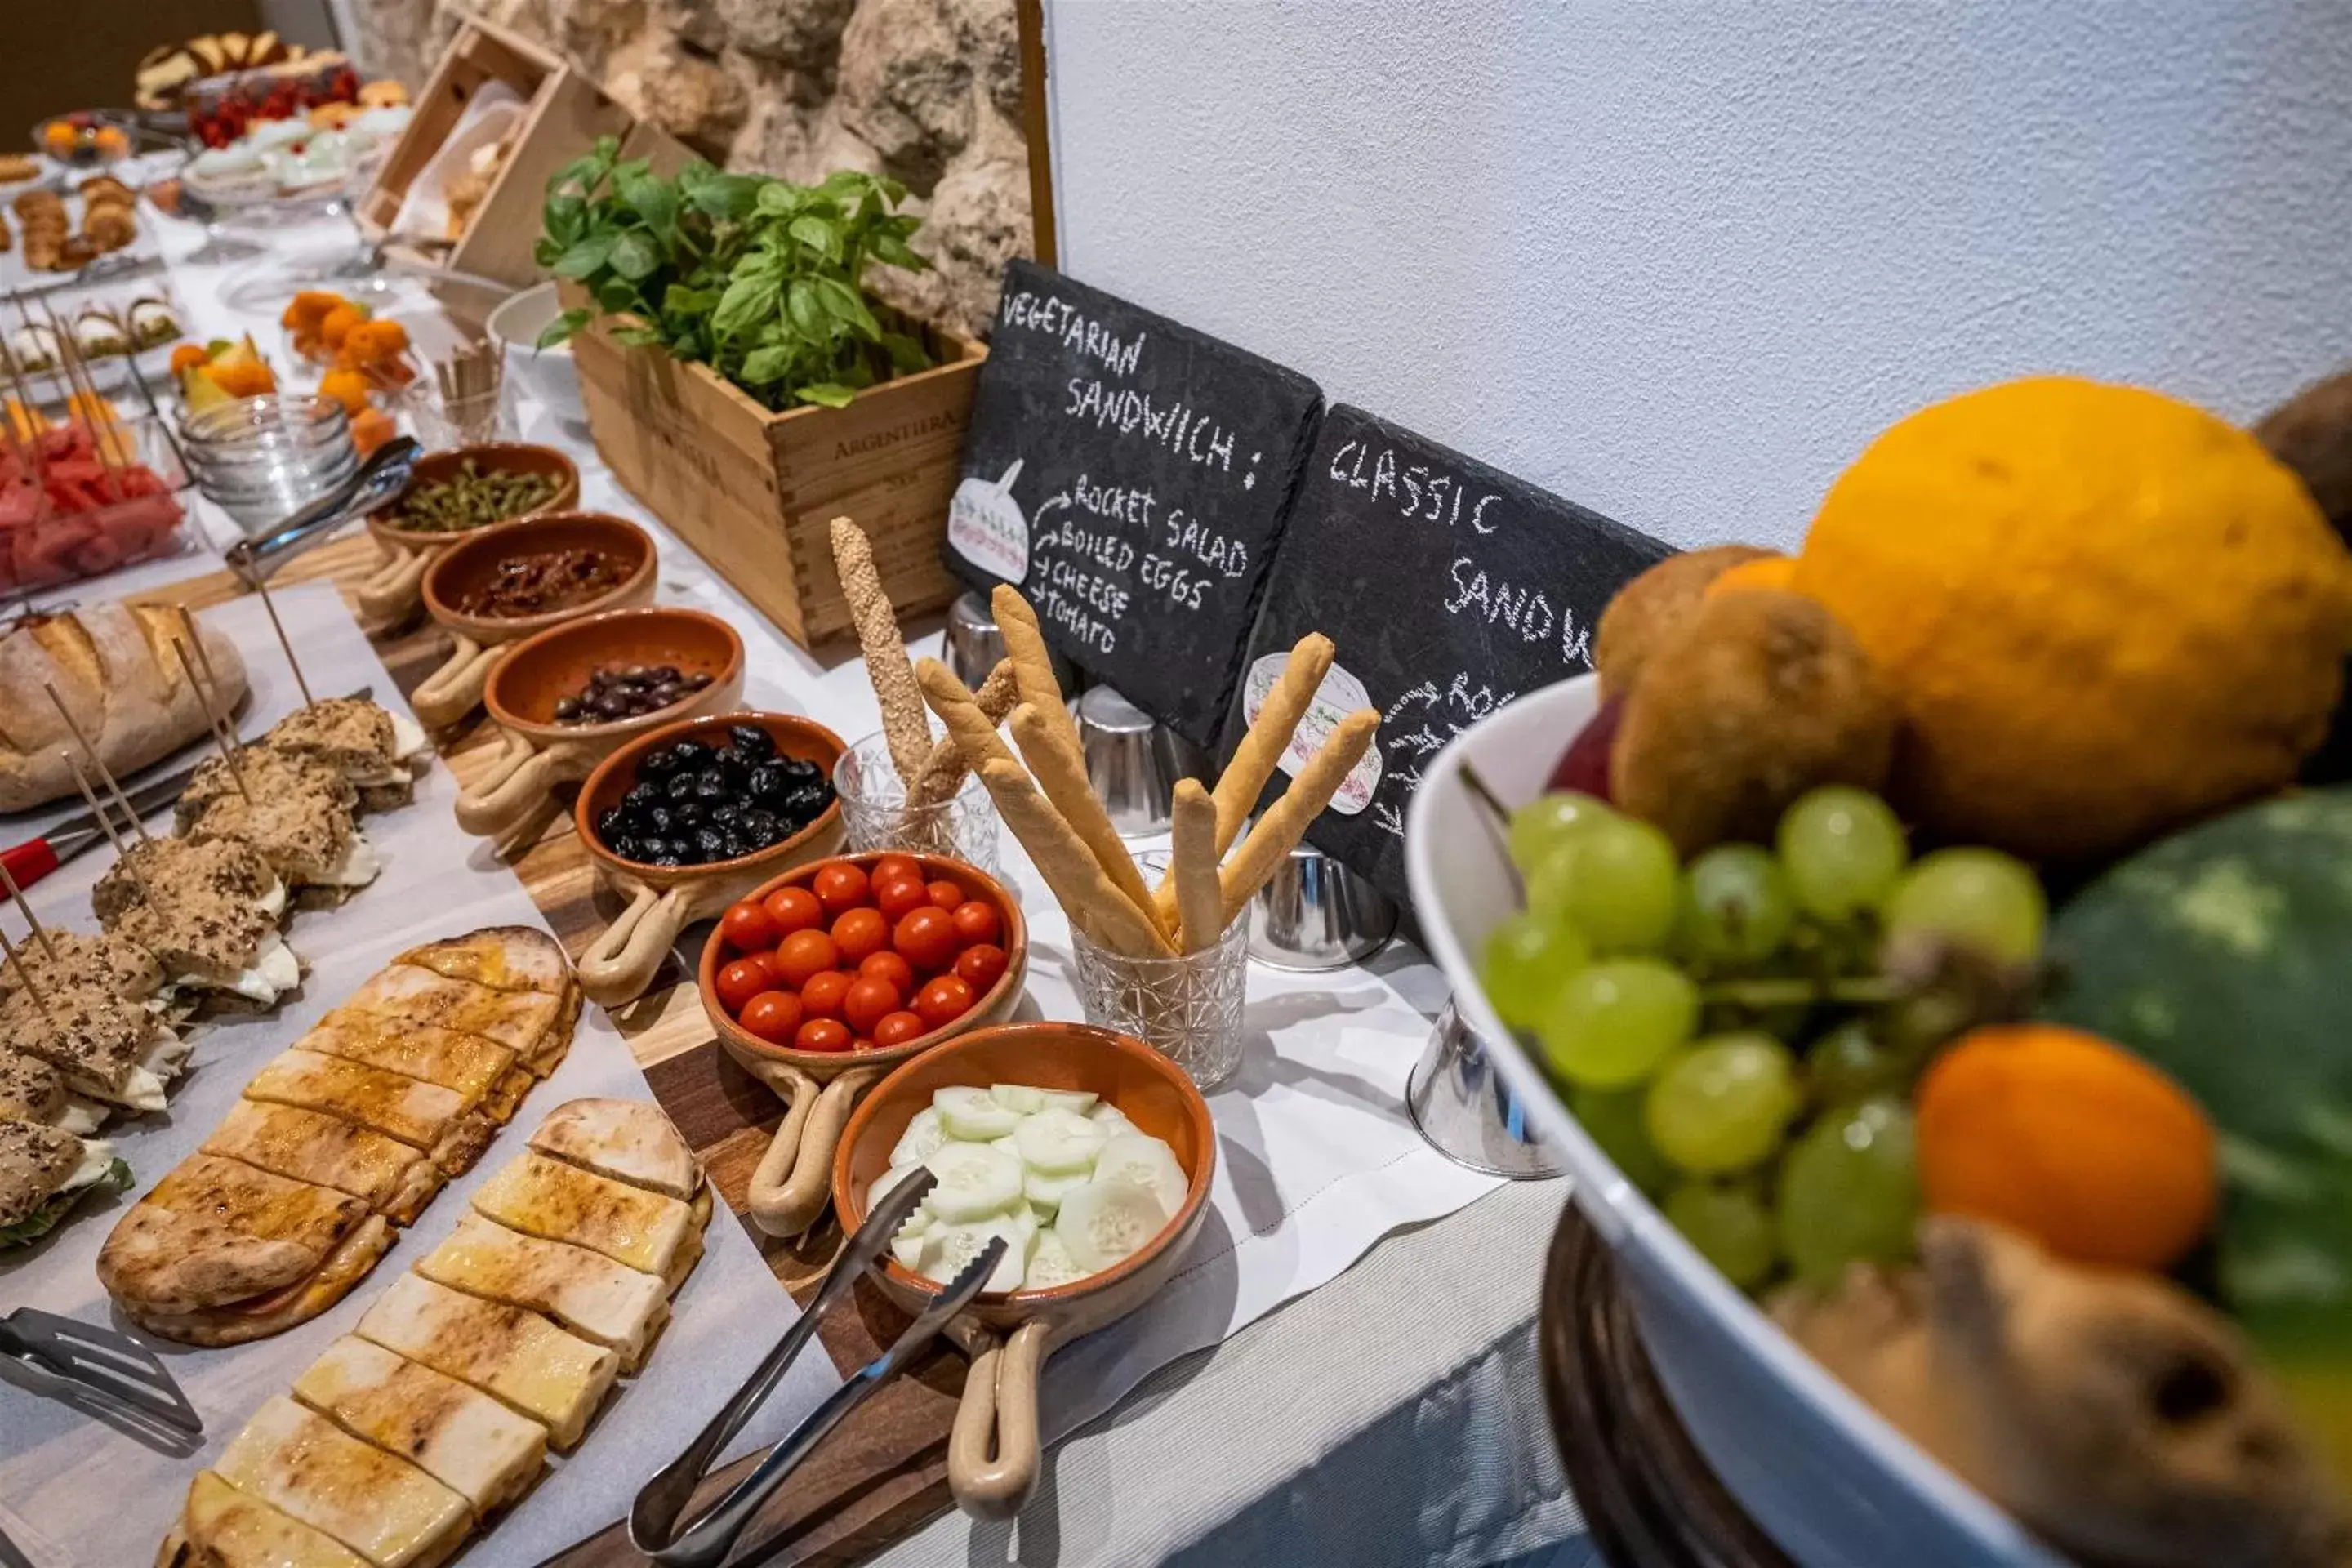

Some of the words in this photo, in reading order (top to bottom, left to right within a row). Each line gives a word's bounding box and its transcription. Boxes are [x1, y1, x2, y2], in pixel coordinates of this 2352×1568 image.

[1004, 292, 1147, 378] VEGETARIAN
[834, 409, 957, 461] ARGENTIERA
[1075, 473, 1157, 528] ROCKET
[1166, 508, 1249, 577] SALAD
[1330, 441, 1502, 535] CLASSIC
[1052, 560, 1130, 620] CHEESE
[1061, 521, 1134, 572] BOILED
[1141, 552, 1213, 611] EGGS
[1046, 589, 1116, 653] TOMATO
